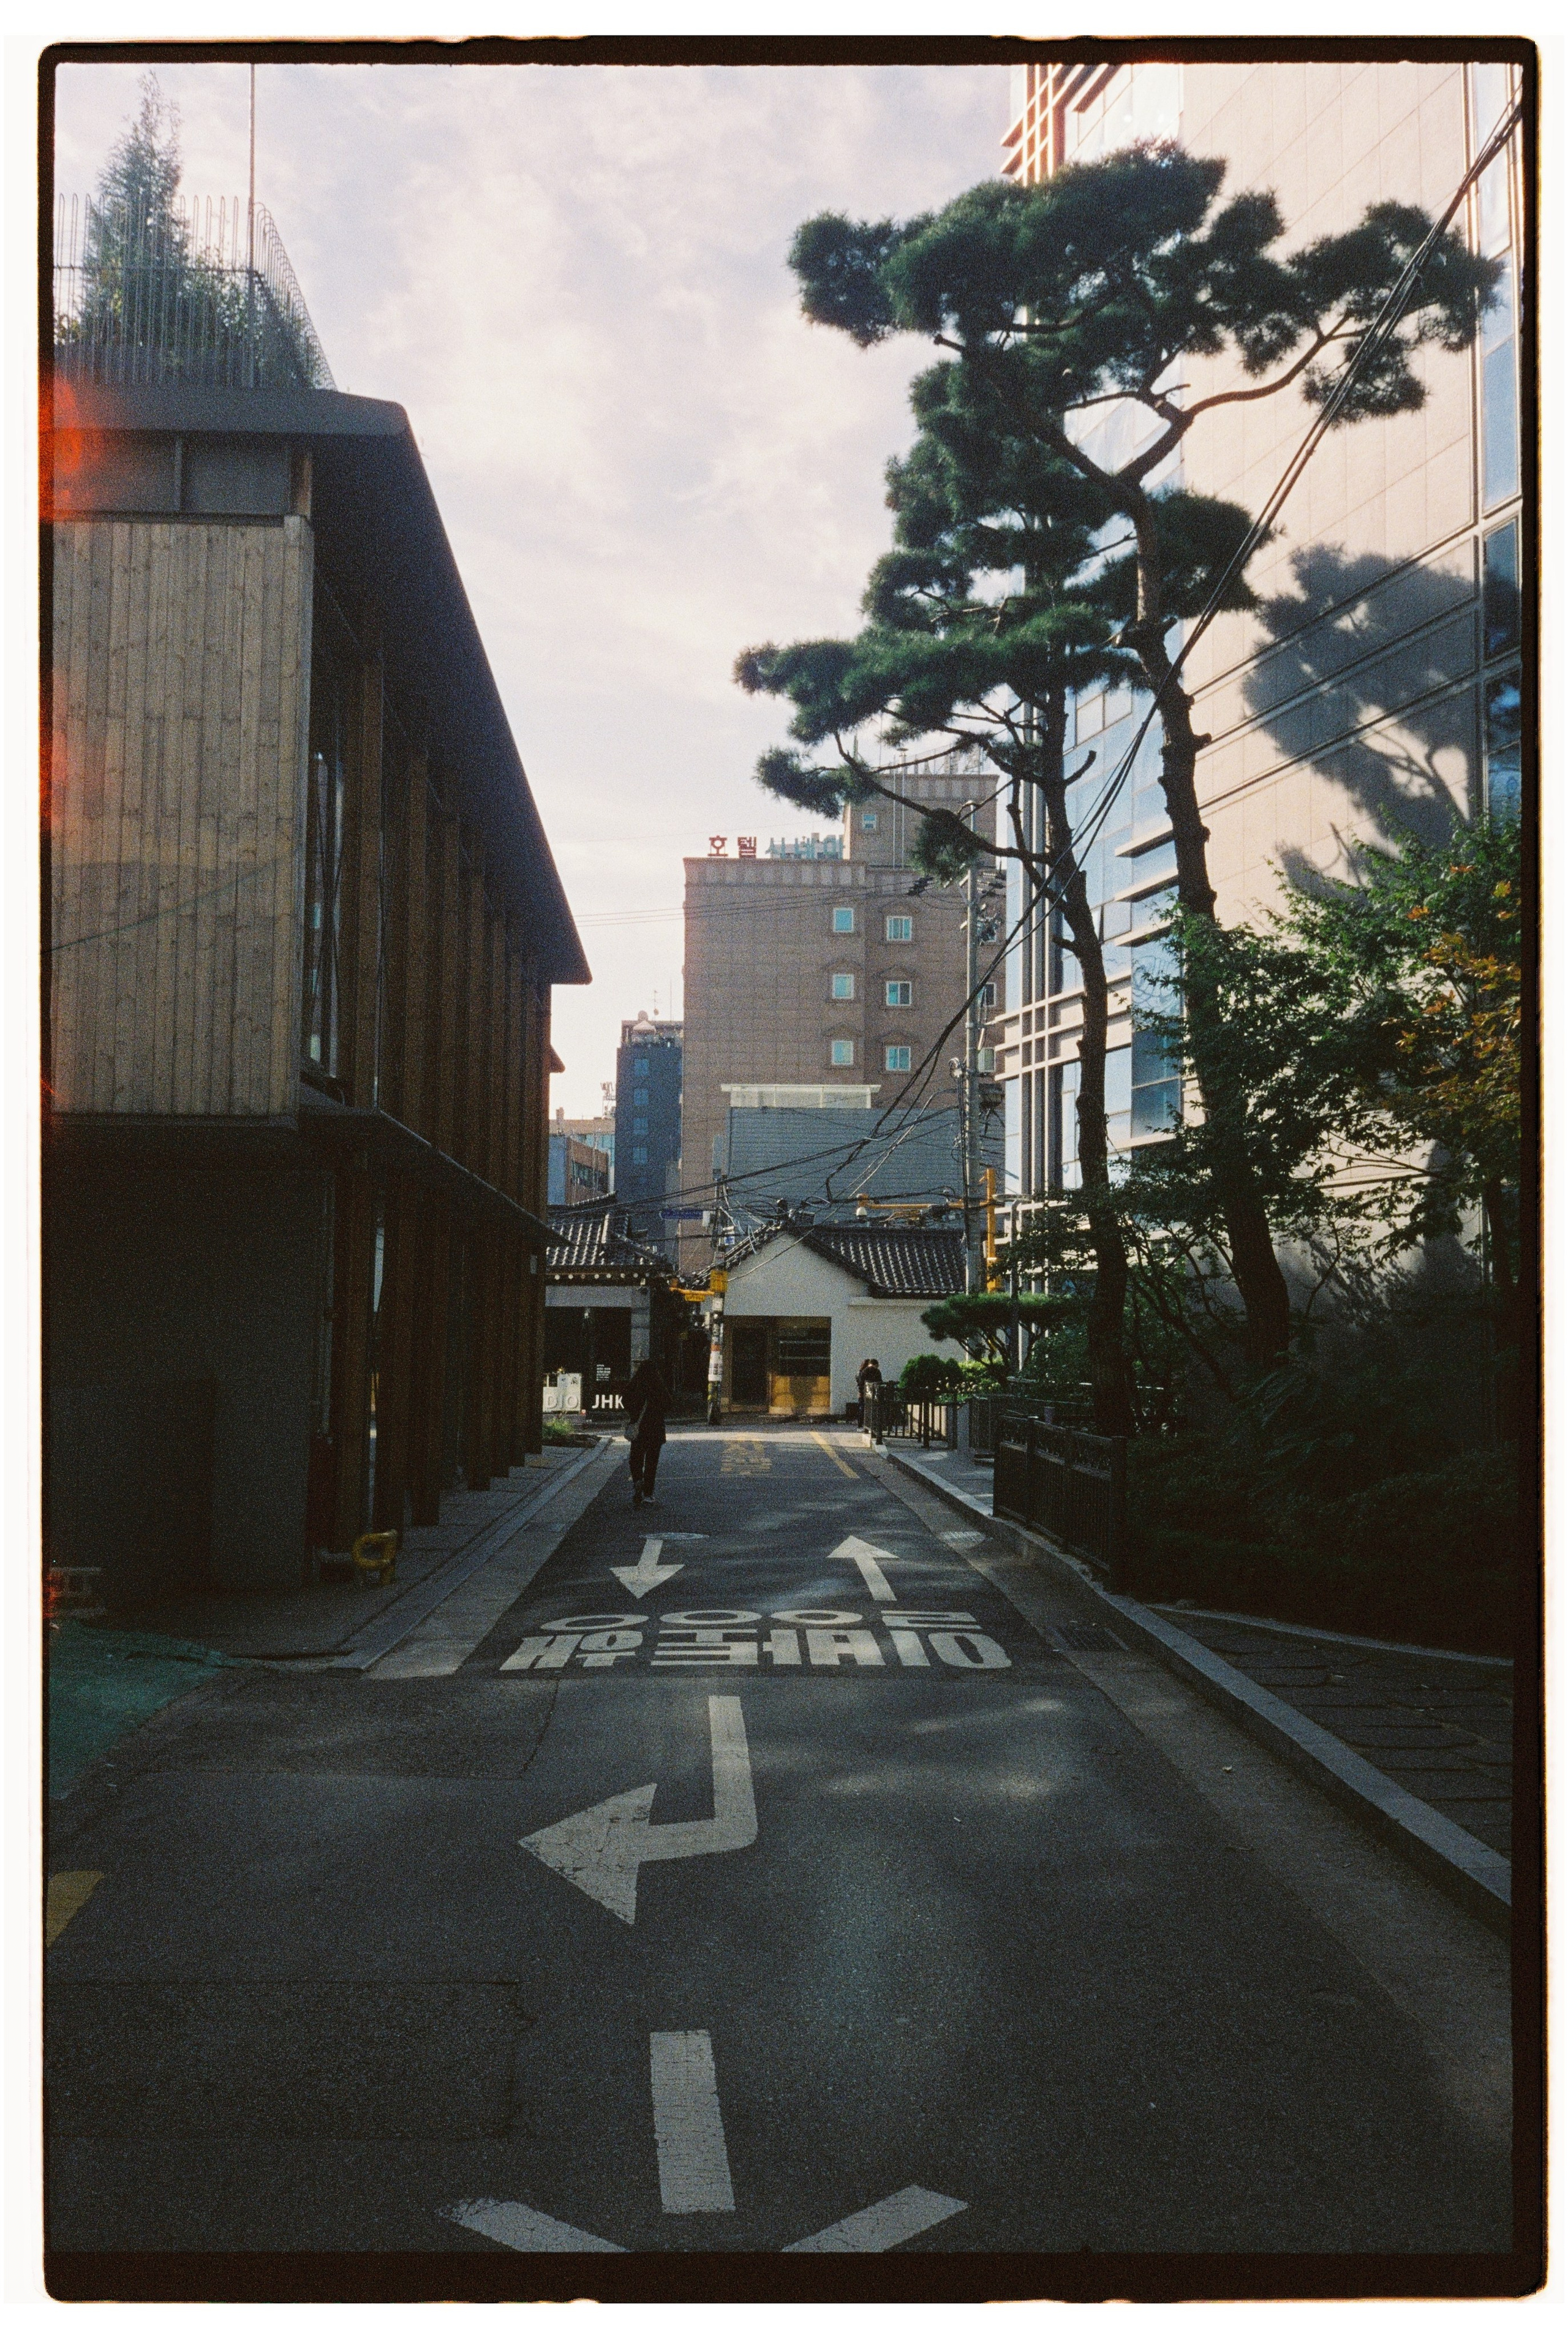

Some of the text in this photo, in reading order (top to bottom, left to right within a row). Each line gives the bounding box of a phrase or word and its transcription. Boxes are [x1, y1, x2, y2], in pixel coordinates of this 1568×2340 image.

[707, 835, 756, 858] 호텔
[592, 1394, 625, 1409] JHK
[499, 1610, 1012, 1670] 일방통행
